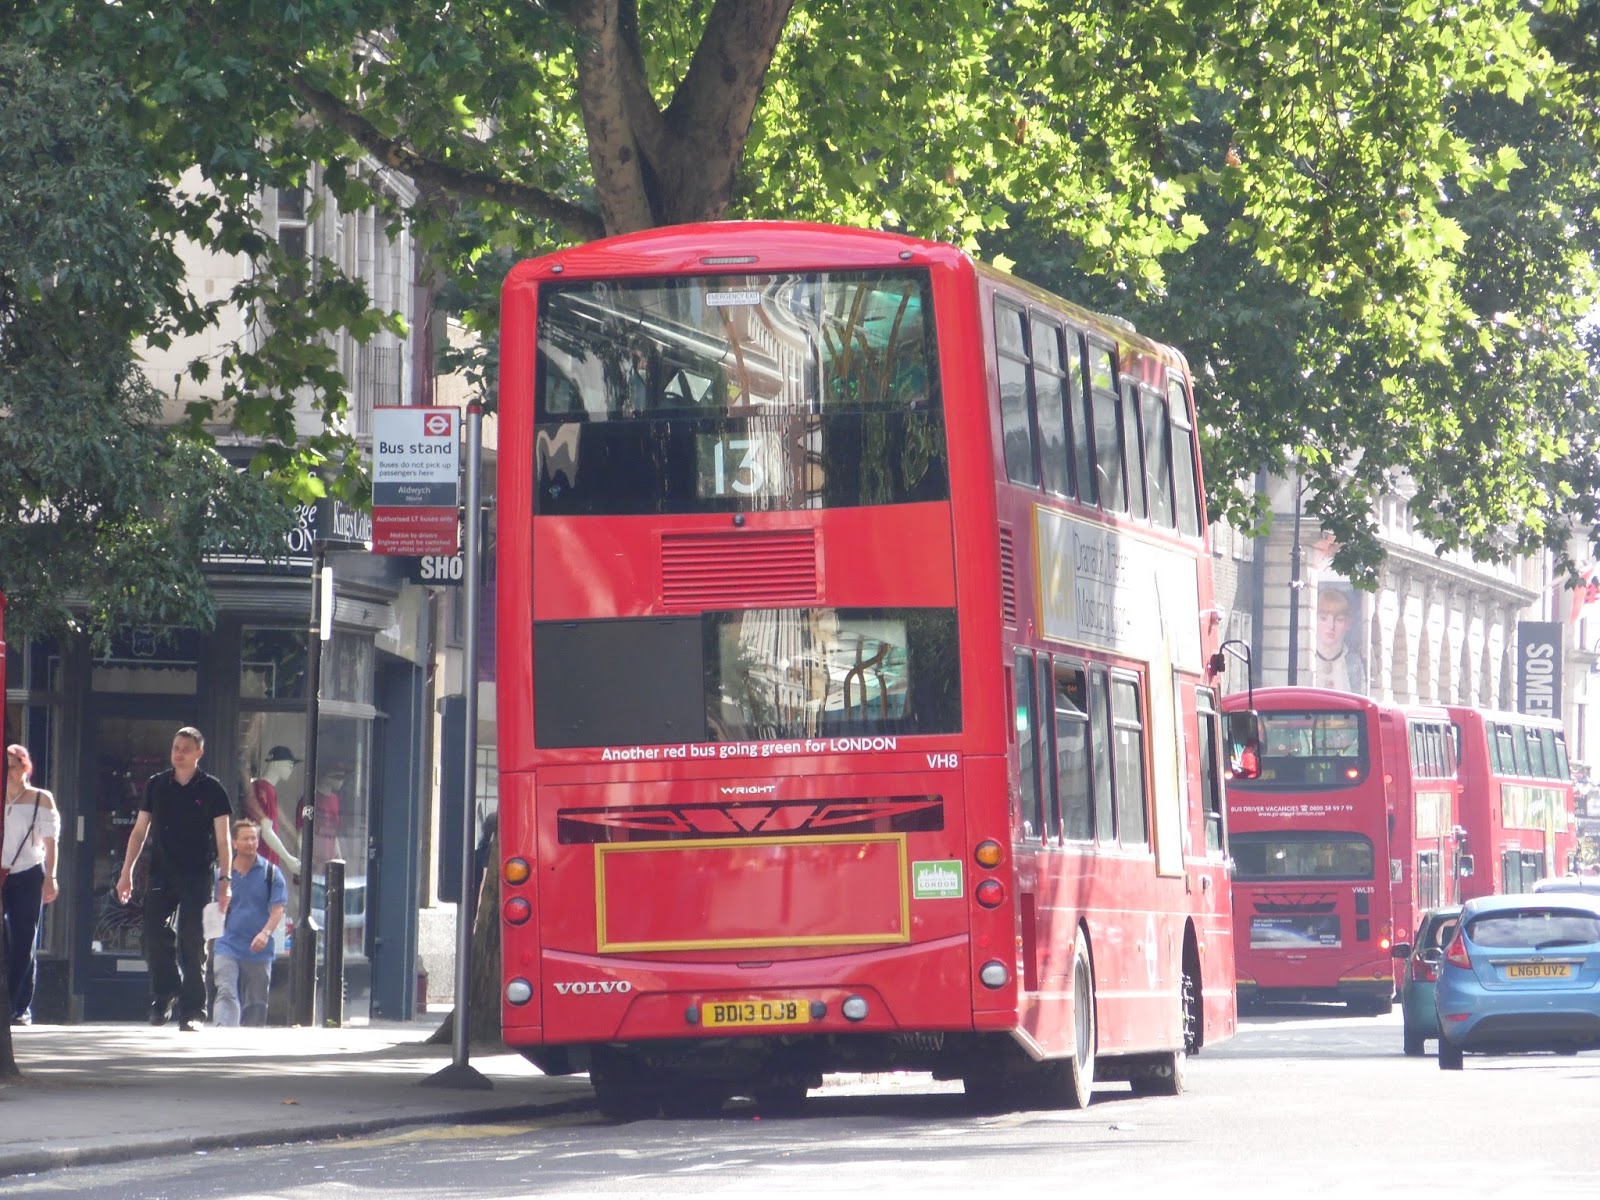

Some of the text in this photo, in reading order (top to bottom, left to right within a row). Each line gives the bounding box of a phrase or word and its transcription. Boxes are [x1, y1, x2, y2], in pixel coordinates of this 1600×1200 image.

[379, 441, 452, 454] Bus stand
[379, 461, 451, 470] Buses do not pick up
[714, 439, 764, 494] 13
[379, 470, 417, 478] passengers
[397, 486, 431, 496] Aldwych
[420, 555, 463, 580] SHO
[601, 737, 897, 761] Another red bus going green for LONDON
[926, 753, 959, 769] VH8
[720, 784, 776, 795] WRIGHT
[1309, 804, 1323, 812] 0800
[1352, 886, 1375, 894] VWL35
[1510, 965, 1566, 977] LN60 UVZ
[553, 979, 632, 996] VOLVO
[713, 1003, 756, 1023] BD13
